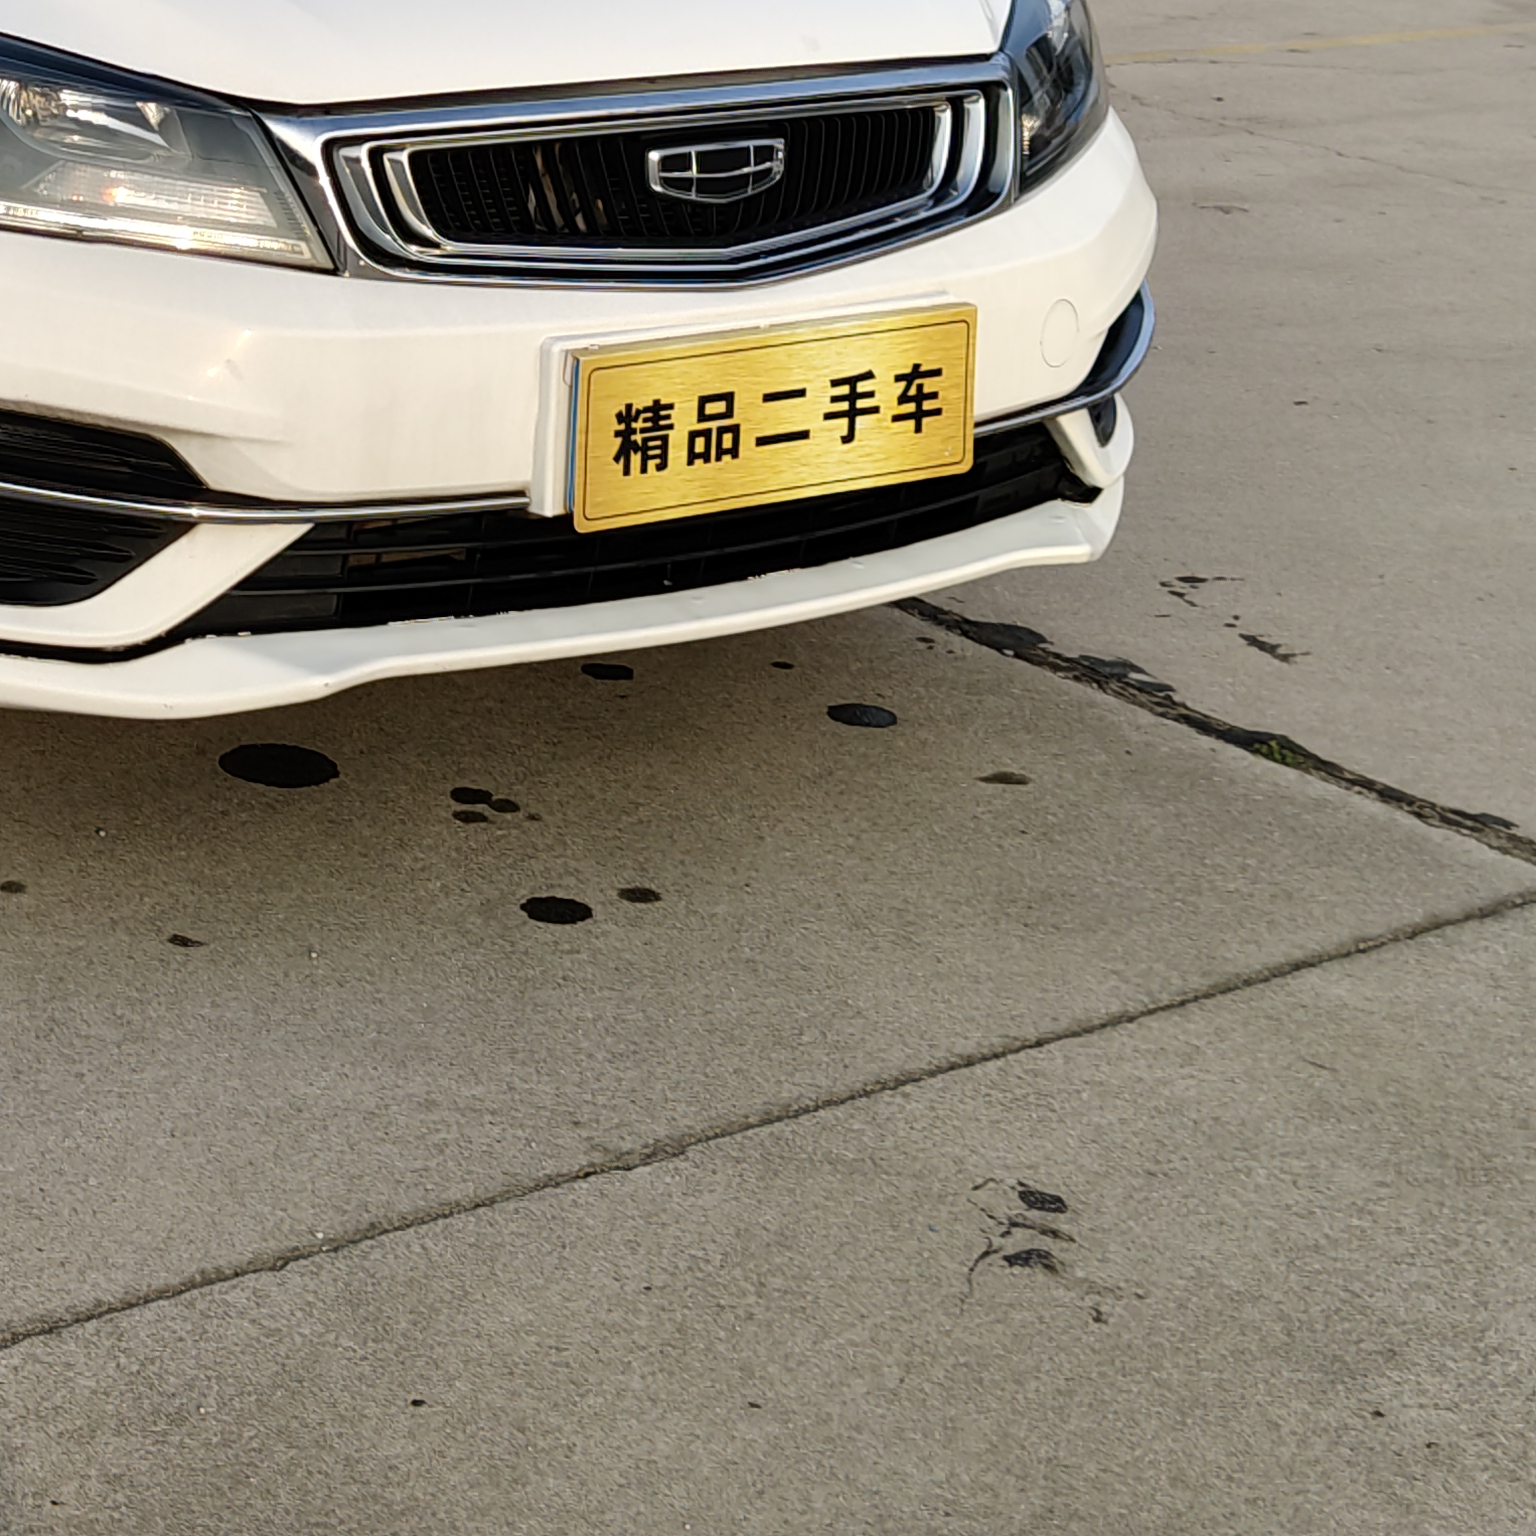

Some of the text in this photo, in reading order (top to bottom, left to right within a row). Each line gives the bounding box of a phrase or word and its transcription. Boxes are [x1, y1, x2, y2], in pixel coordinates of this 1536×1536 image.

[612, 363, 944, 477] 精品二手车
